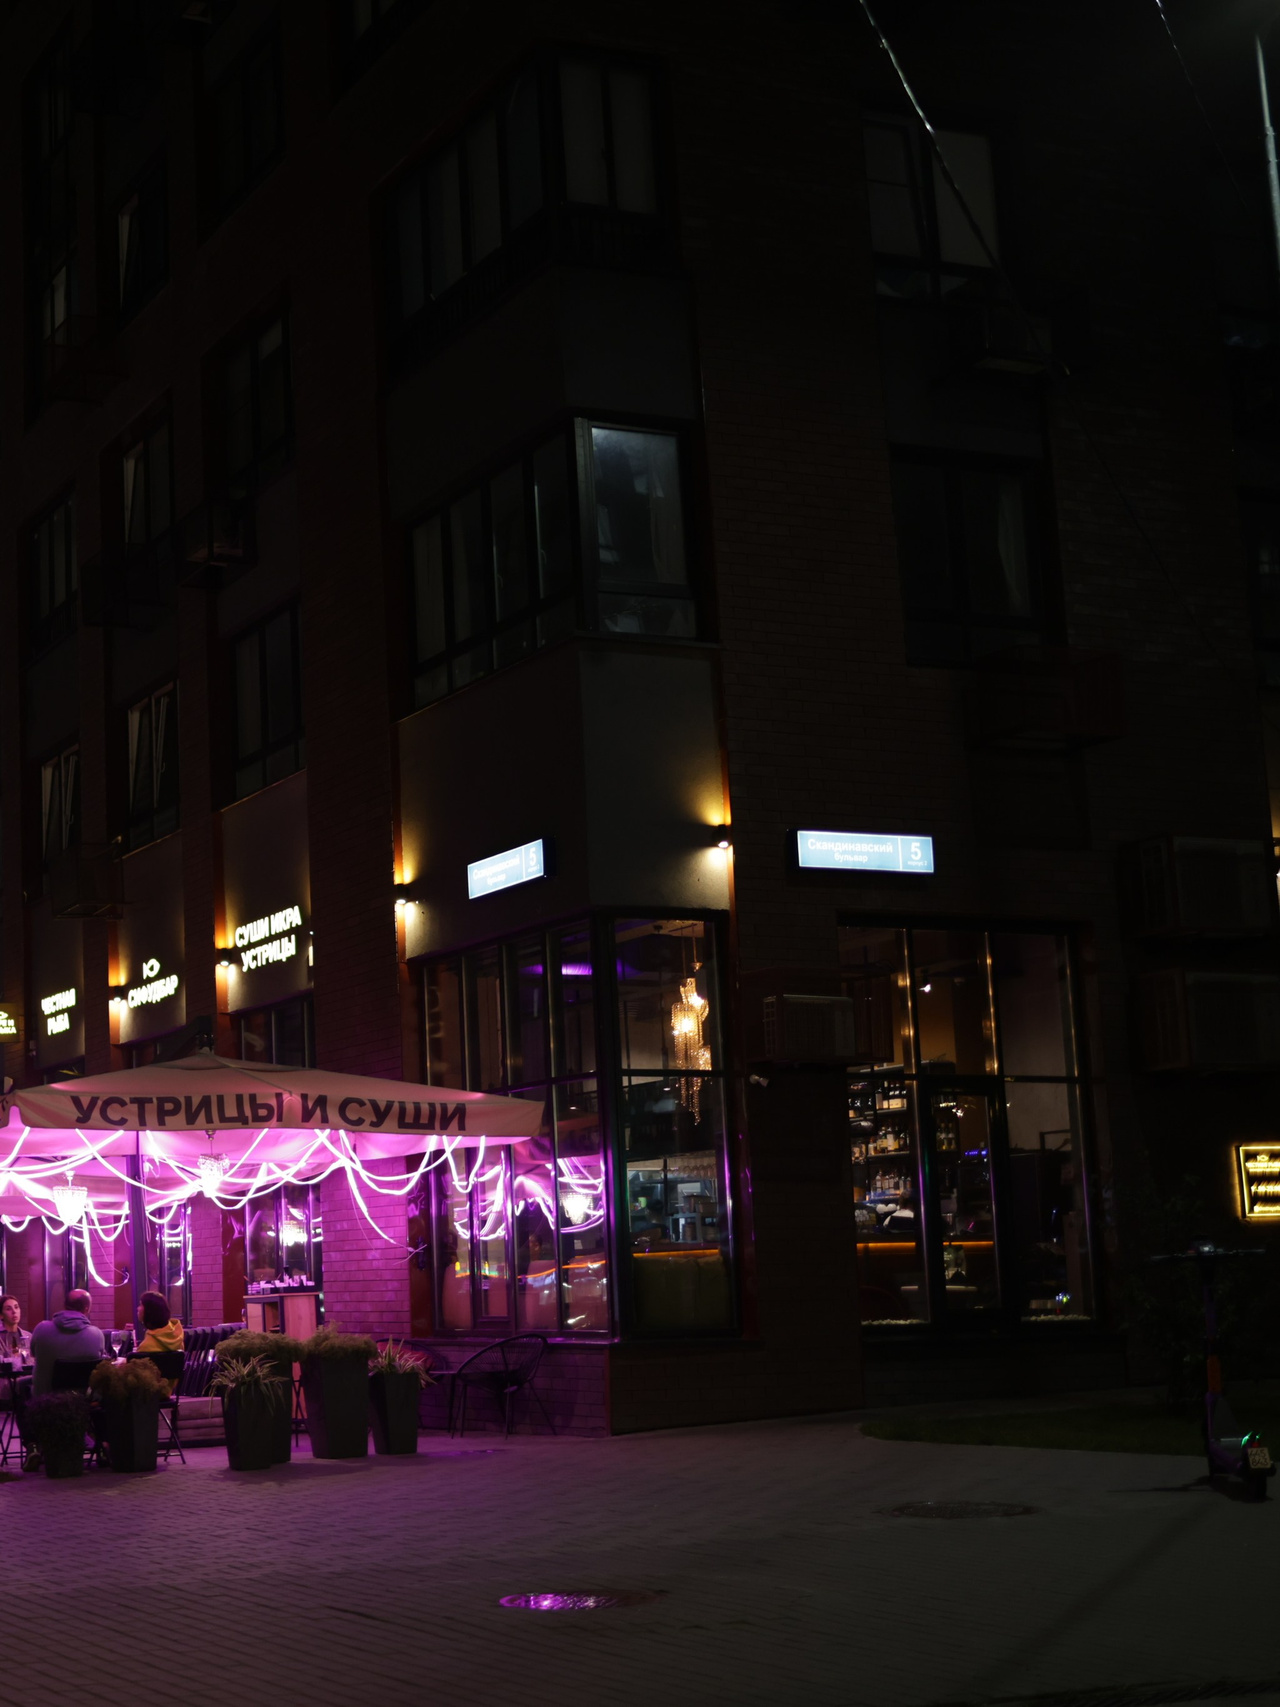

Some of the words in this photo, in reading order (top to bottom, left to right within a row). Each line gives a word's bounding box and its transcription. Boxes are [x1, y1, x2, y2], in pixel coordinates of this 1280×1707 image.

[529, 847, 537, 866] 5
[807, 838, 894, 854] Скандинавский
[833, 852, 869, 864] бульвар
[910, 842, 922, 861] 5
[234, 916, 270, 948] СУШИ
[270, 905, 302, 935] ИКРА
[241, 934, 296, 972] УСТРИЦЫ
[41, 988, 76, 1015] ЧЕСТНАЯ
[127, 974, 179, 1009] СИФУДБАР
[47, 1012, 70, 1036] РЫБА
[70, 1092, 284, 1127] УСТРИЦЫ
[300, 1093, 330, 1124] И
[337, 1097, 467, 1131] СУШИ
